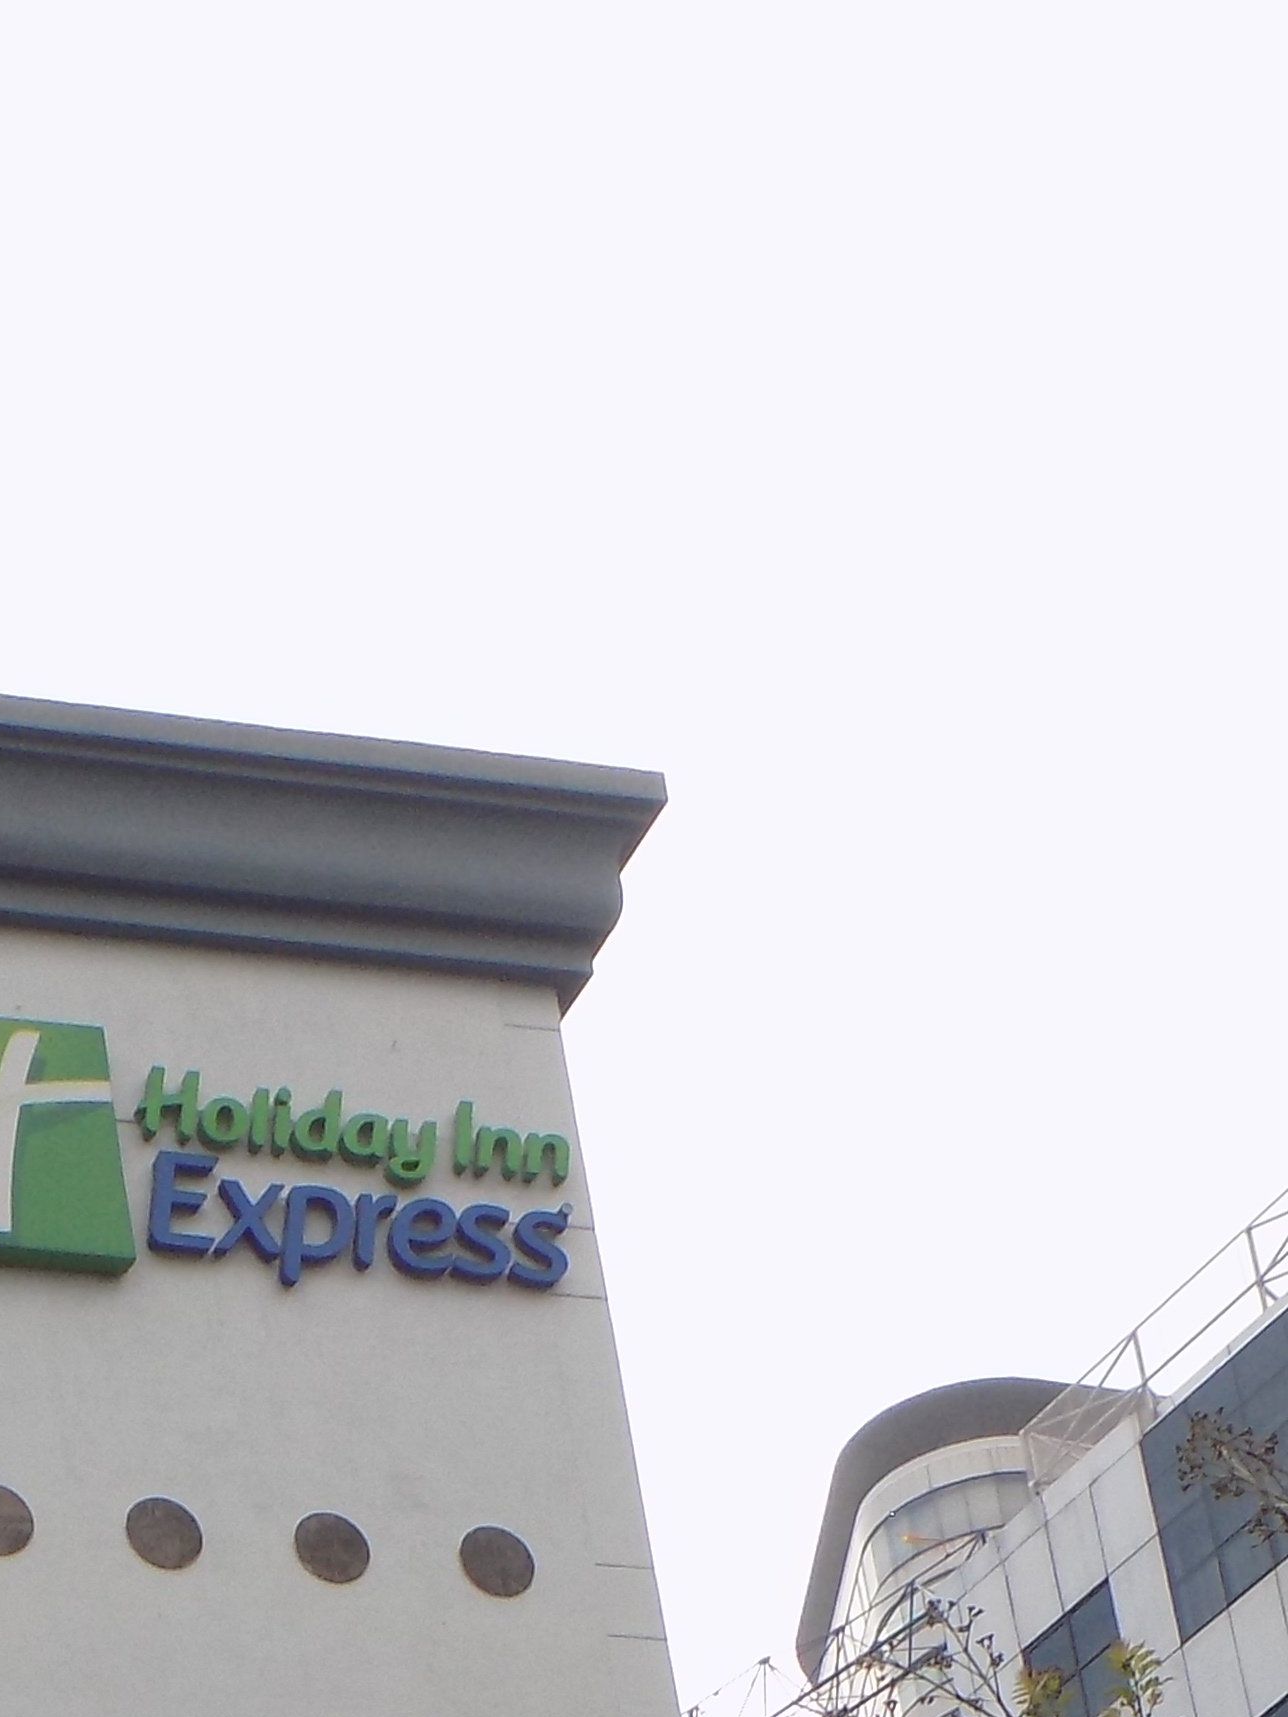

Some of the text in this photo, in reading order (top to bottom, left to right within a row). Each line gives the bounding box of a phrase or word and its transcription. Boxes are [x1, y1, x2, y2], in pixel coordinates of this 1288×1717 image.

[133, 1064, 571, 1188] Holiday Inn
[146, 1149, 572, 1289] Express
